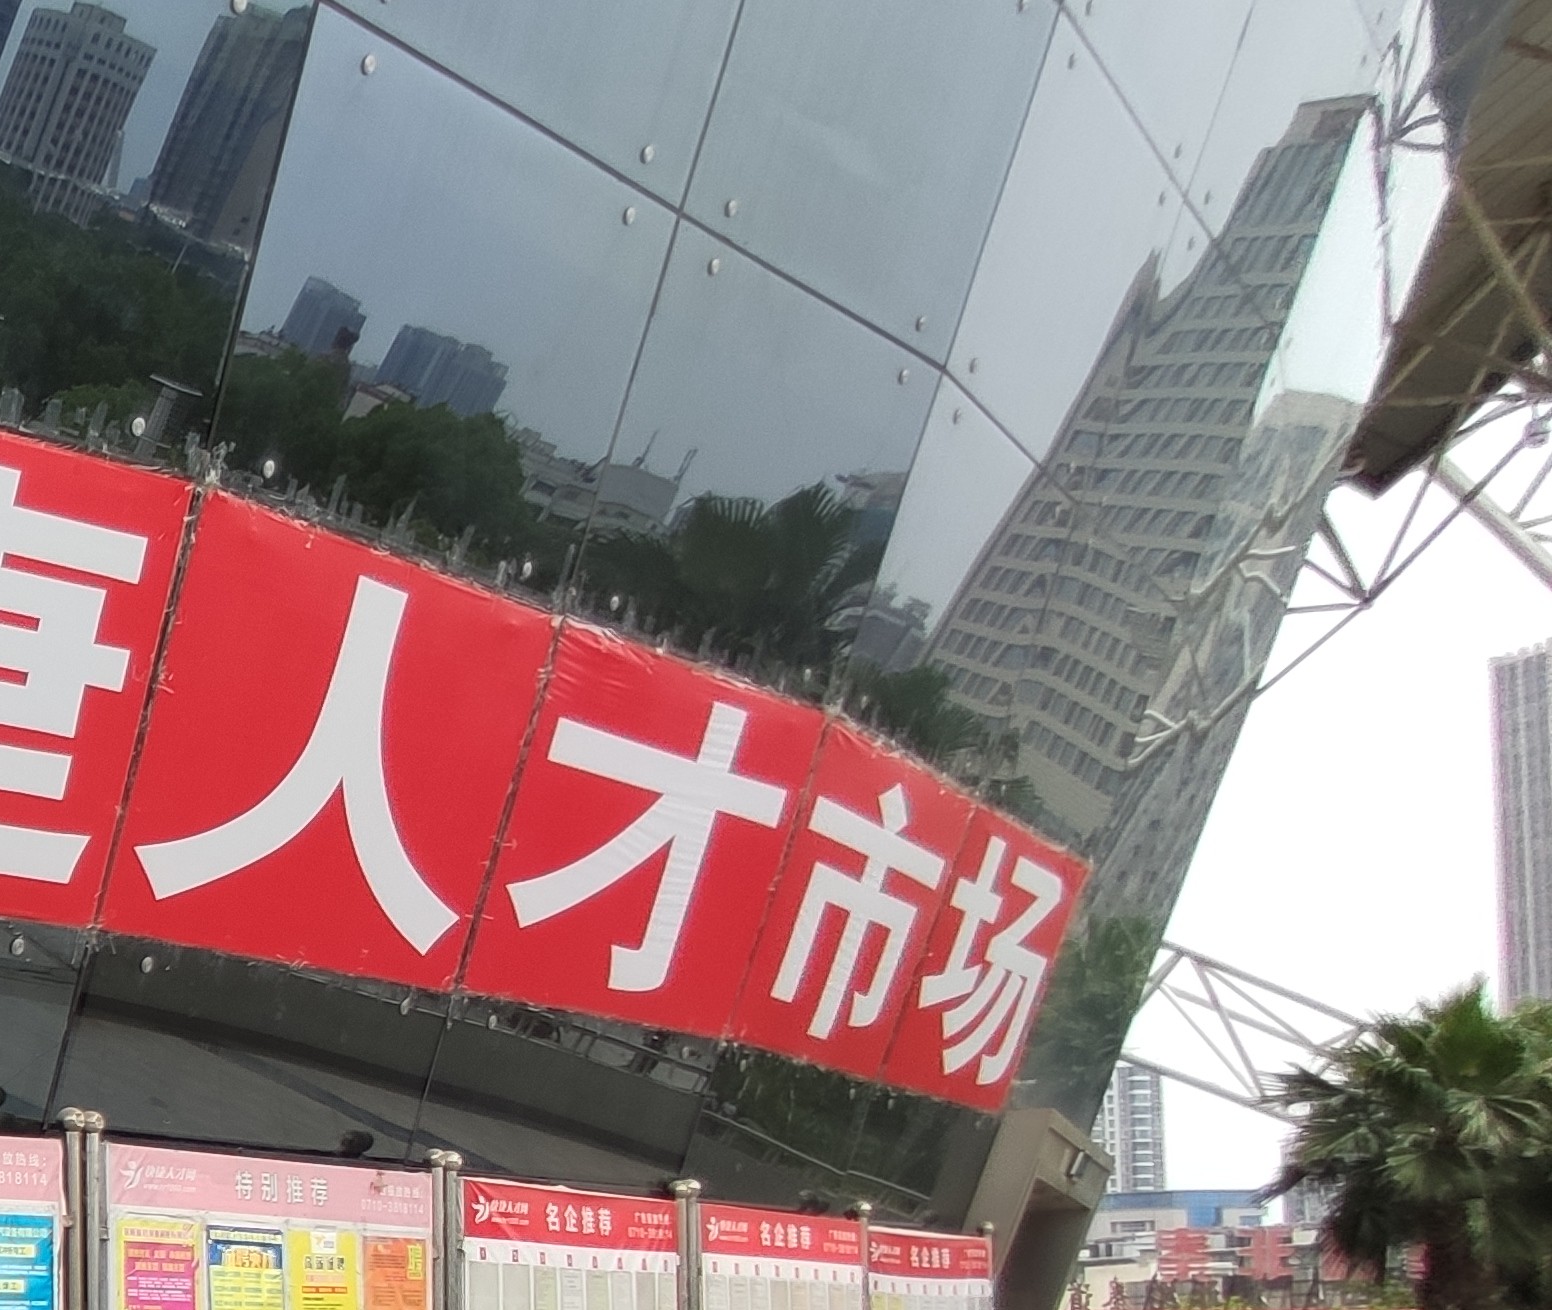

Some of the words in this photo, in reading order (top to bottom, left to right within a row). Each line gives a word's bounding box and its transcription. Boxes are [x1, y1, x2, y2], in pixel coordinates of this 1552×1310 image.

[145, 1164, 197, 1182] 快捷人才网
[234, 1169, 329, 1207] 特别推荐
[545, 1202, 613, 1237] 名企推荐
[759, 1220, 812, 1250] 名企推荐
[909, 1245, 950, 1270] 名企推荐
